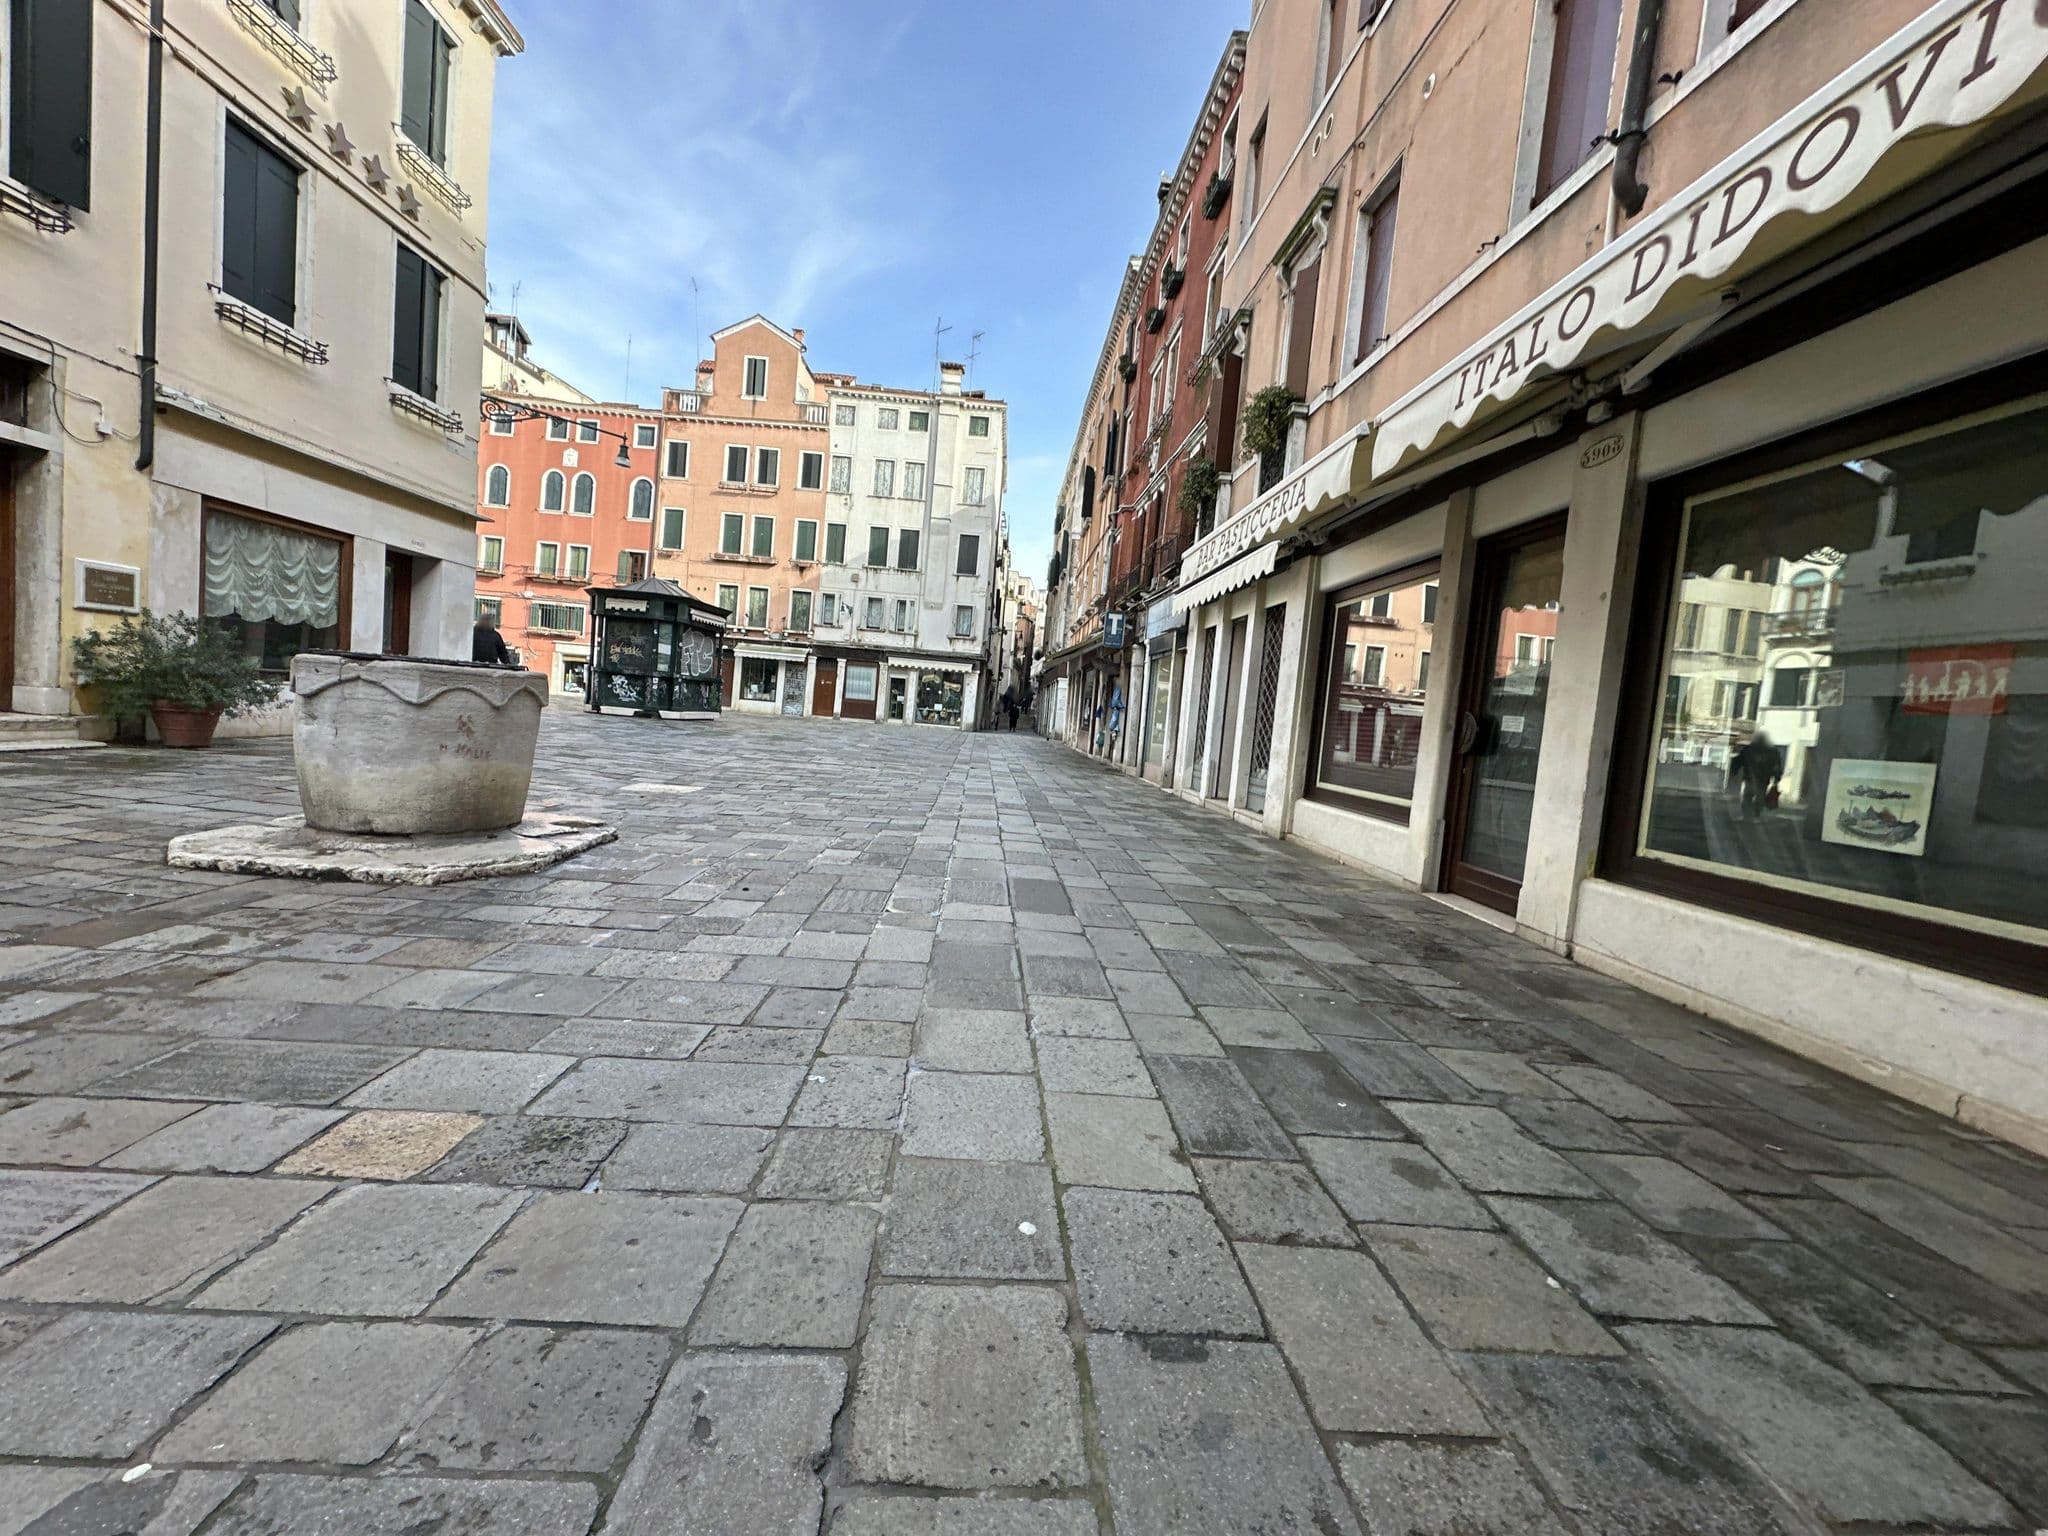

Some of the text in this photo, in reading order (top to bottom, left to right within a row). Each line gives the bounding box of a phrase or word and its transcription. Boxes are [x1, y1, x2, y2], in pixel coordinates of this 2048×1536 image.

[1454, 0, 2048, 411] ITALO DIDOVI
[1197, 476, 1306, 569] BAR PASTICCERIA
[1108, 613, 1123, 635] T
